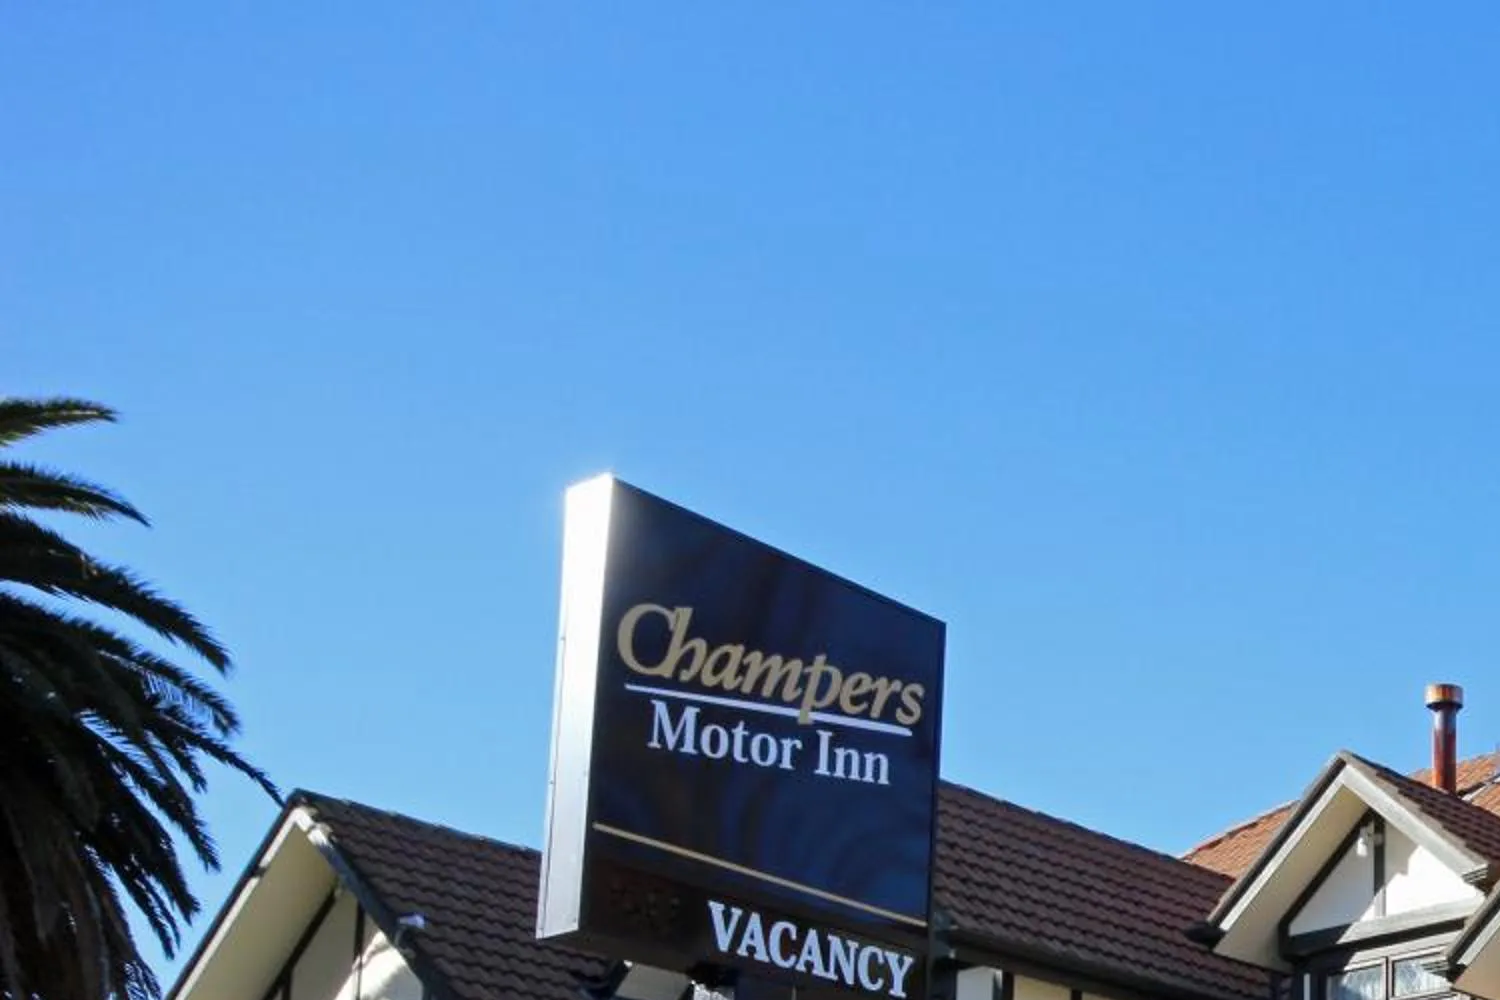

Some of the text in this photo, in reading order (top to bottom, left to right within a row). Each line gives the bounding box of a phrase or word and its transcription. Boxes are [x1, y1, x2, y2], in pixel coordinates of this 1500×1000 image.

[617, 603, 926, 726] Champers
[648, 699, 890, 785] Motor Inn
[708, 900, 914, 999] VACANCY
